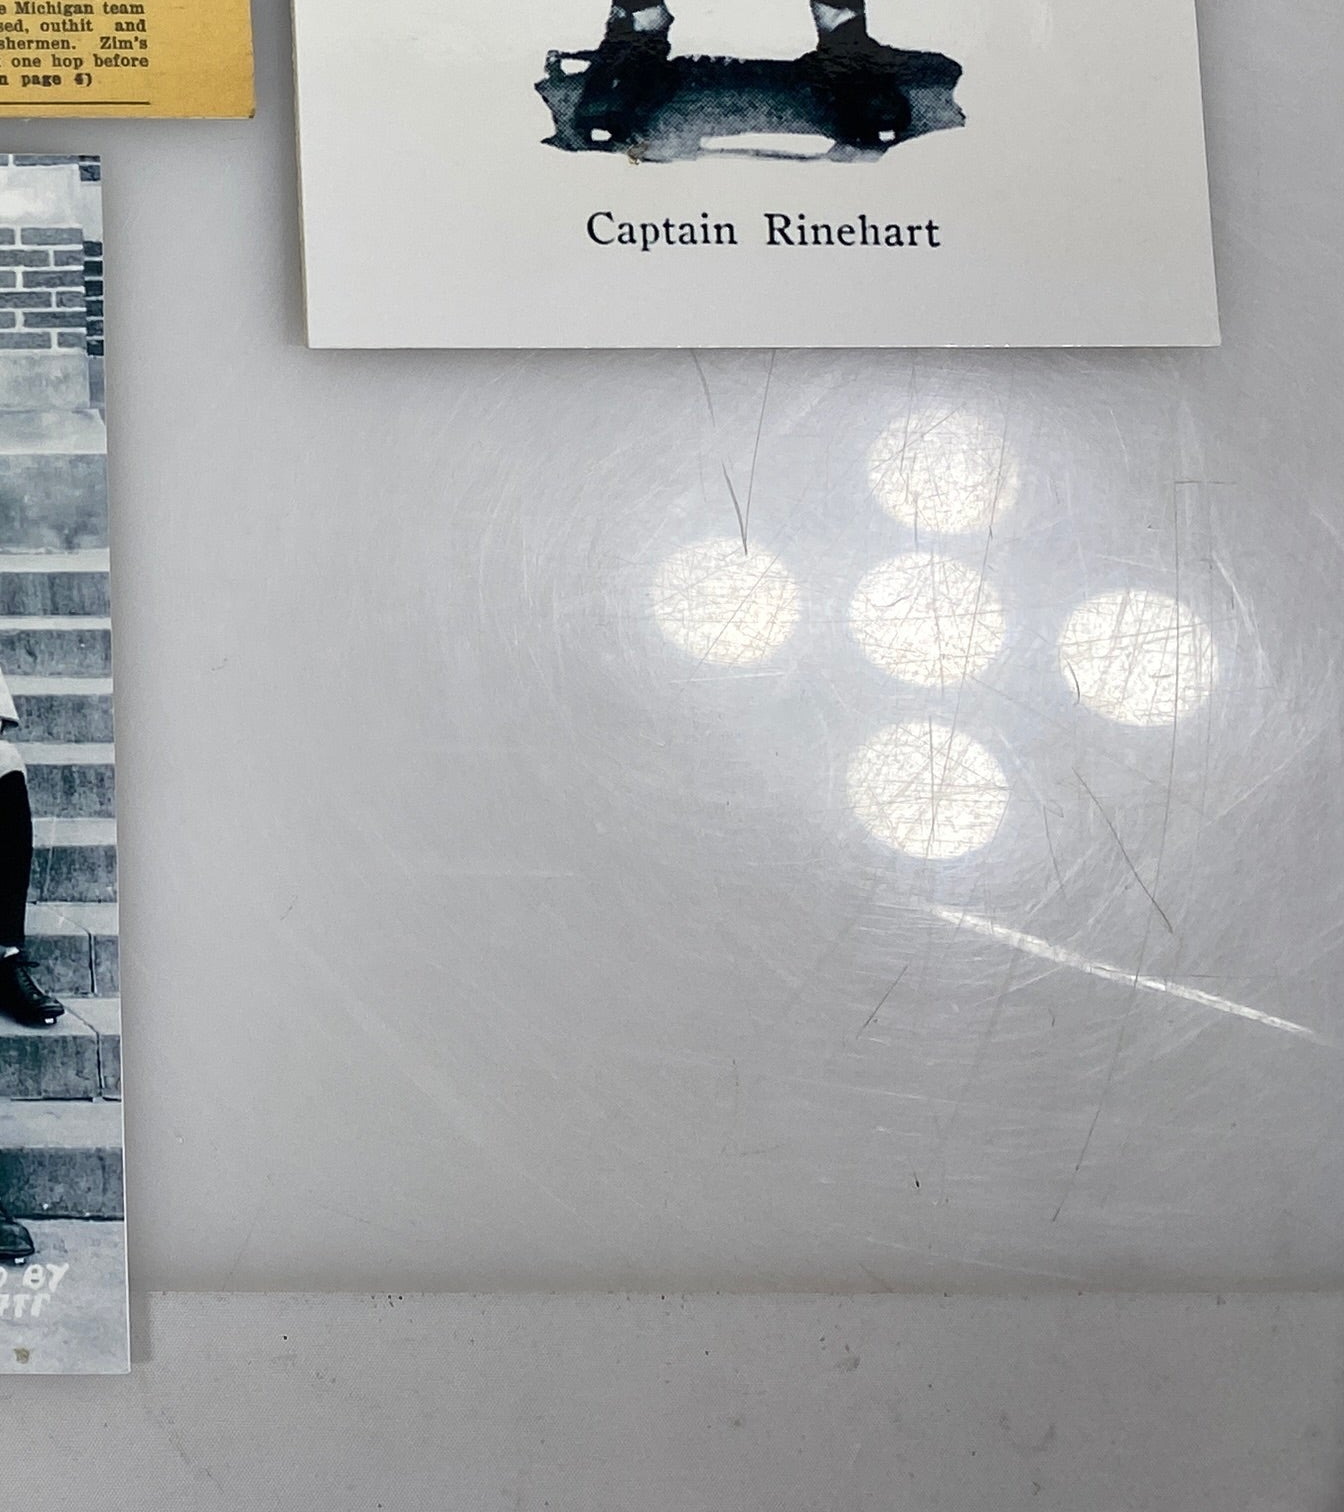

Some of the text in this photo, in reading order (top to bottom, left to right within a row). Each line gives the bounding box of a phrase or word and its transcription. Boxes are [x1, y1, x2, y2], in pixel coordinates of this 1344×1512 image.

[10, 56, 42, 68] one
[50, 53, 84, 71] hop
[92, 52, 149, 68] before
[586, 210, 942, 253] Captain Rinehart
[22, 1263, 70, 1292] BY
